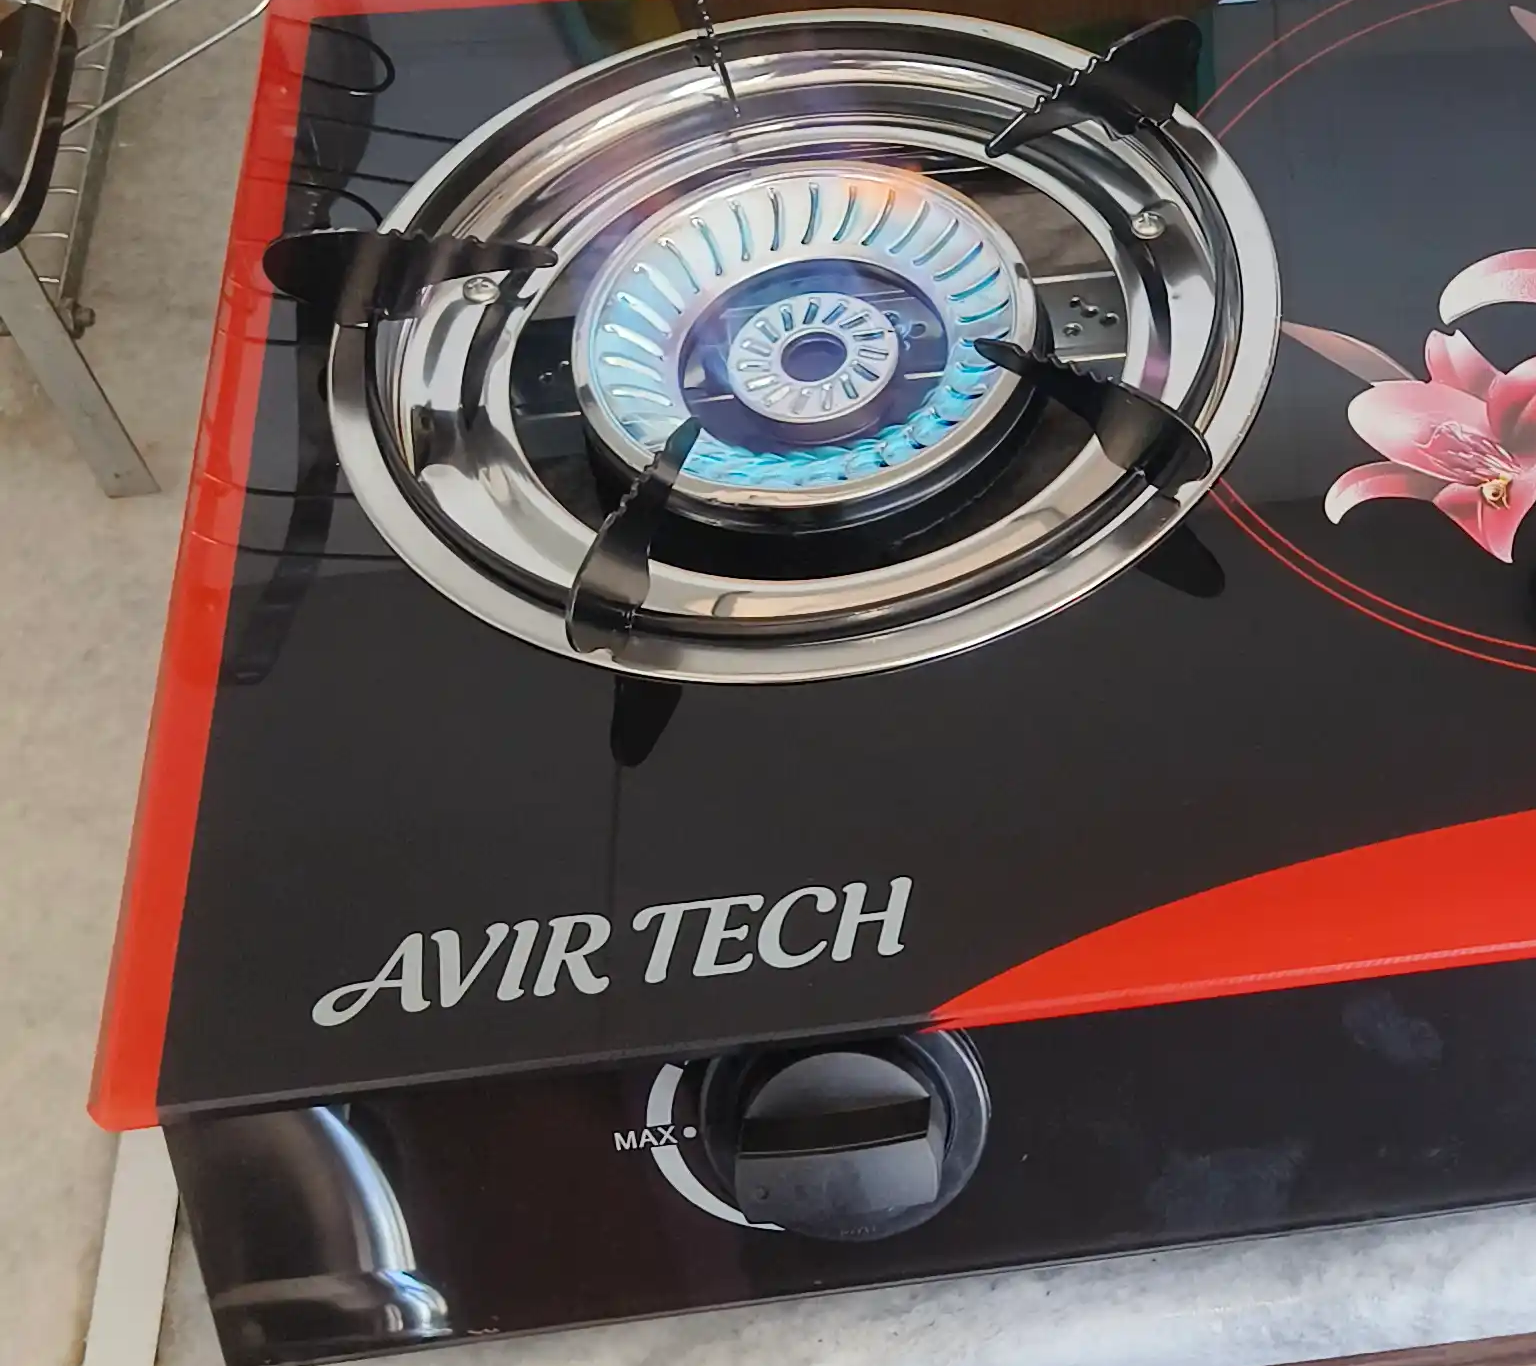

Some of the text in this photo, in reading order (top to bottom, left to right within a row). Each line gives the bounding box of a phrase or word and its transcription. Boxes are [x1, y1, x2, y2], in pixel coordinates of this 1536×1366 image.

[312, 877, 912, 1027] AVIR TECH
[614, 1126, 678, 1152] MAX
